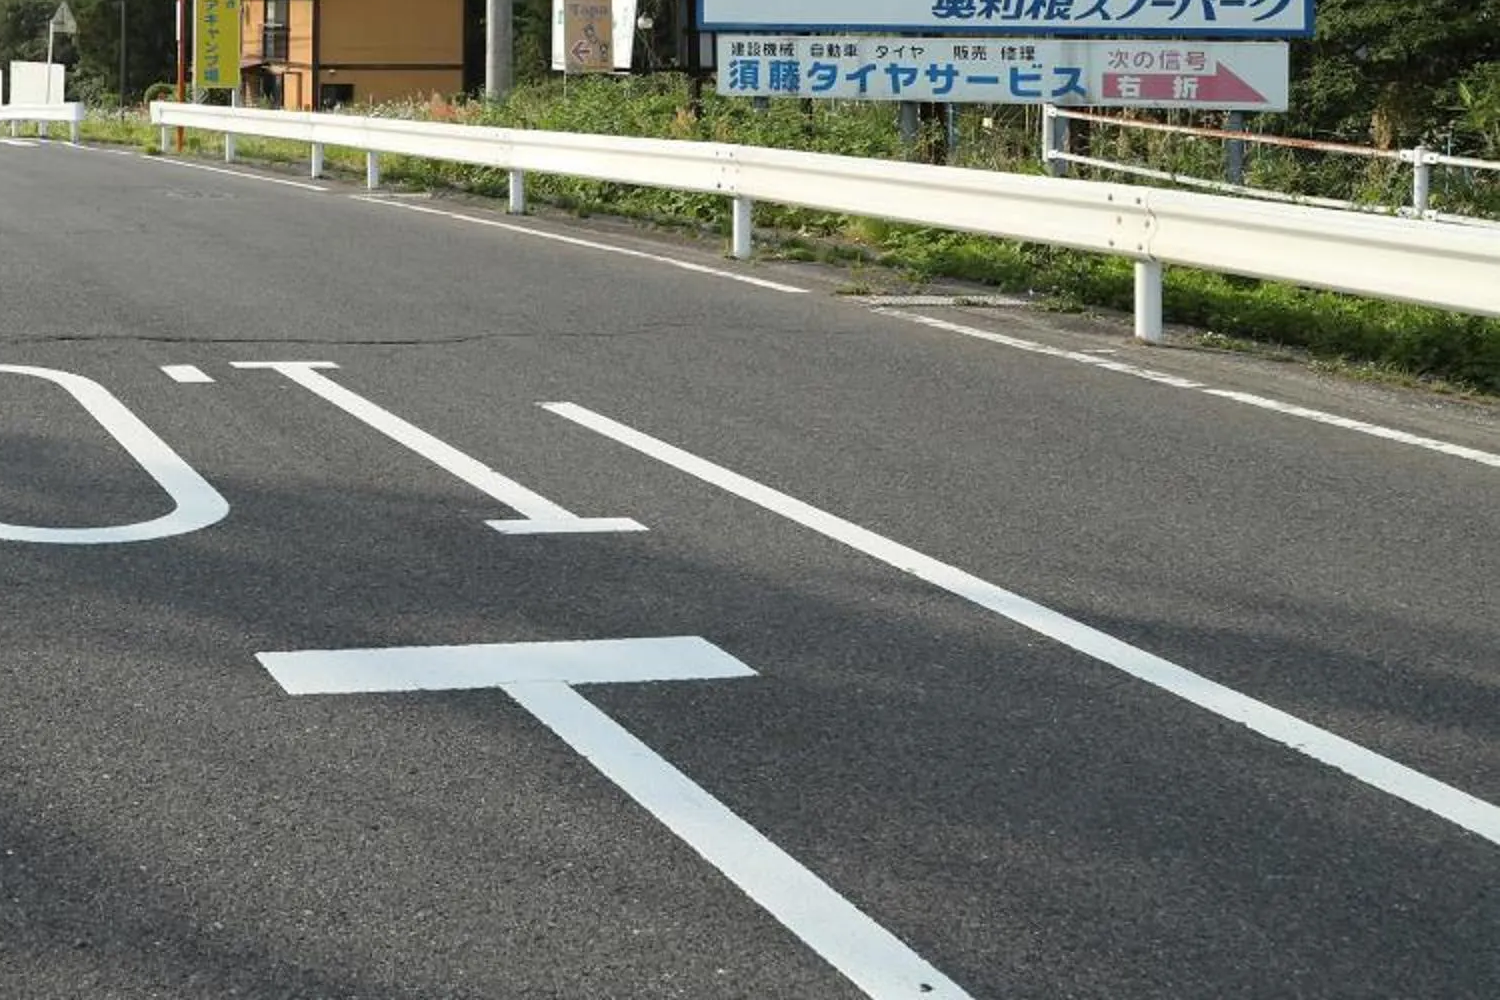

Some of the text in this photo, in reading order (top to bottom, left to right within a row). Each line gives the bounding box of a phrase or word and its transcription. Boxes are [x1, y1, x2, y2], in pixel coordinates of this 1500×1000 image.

[731, 42, 1035, 61] 建設機械 自動車 タイヤ 販売 修理
[1107, 50, 1207, 72] 次の信号
[728, 58, 1087, 98] 須藤タイヤサービス
[1116, 75, 1199, 100] 右折
